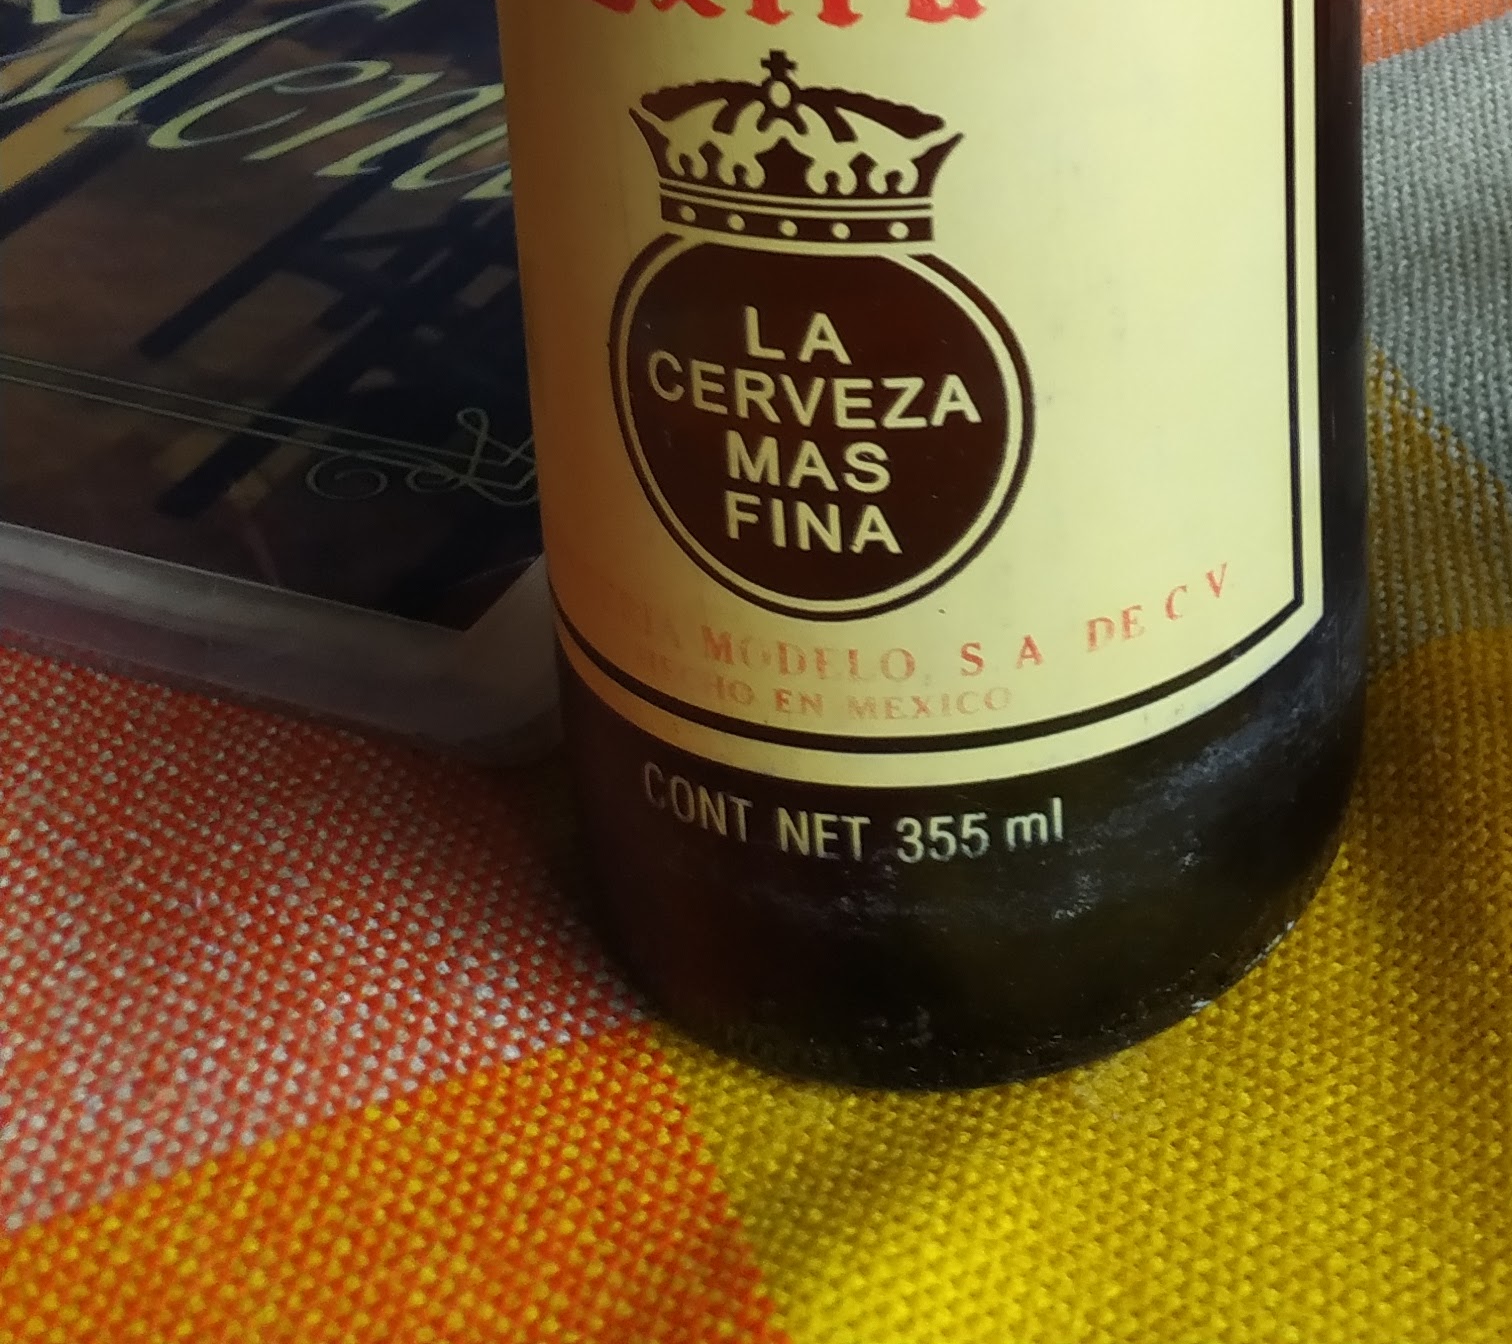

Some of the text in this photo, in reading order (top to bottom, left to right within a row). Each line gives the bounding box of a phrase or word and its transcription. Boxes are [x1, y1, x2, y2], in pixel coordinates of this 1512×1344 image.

[744, 305, 853, 366] LA
[647, 350, 982, 430] CERVEZA
[725, 430, 892, 494] MAS
[724, 490, 902, 555] FINA
[1085, 605, 1146, 653] DE
[643, 761, 1065, 864] CONT NET 355 ml
